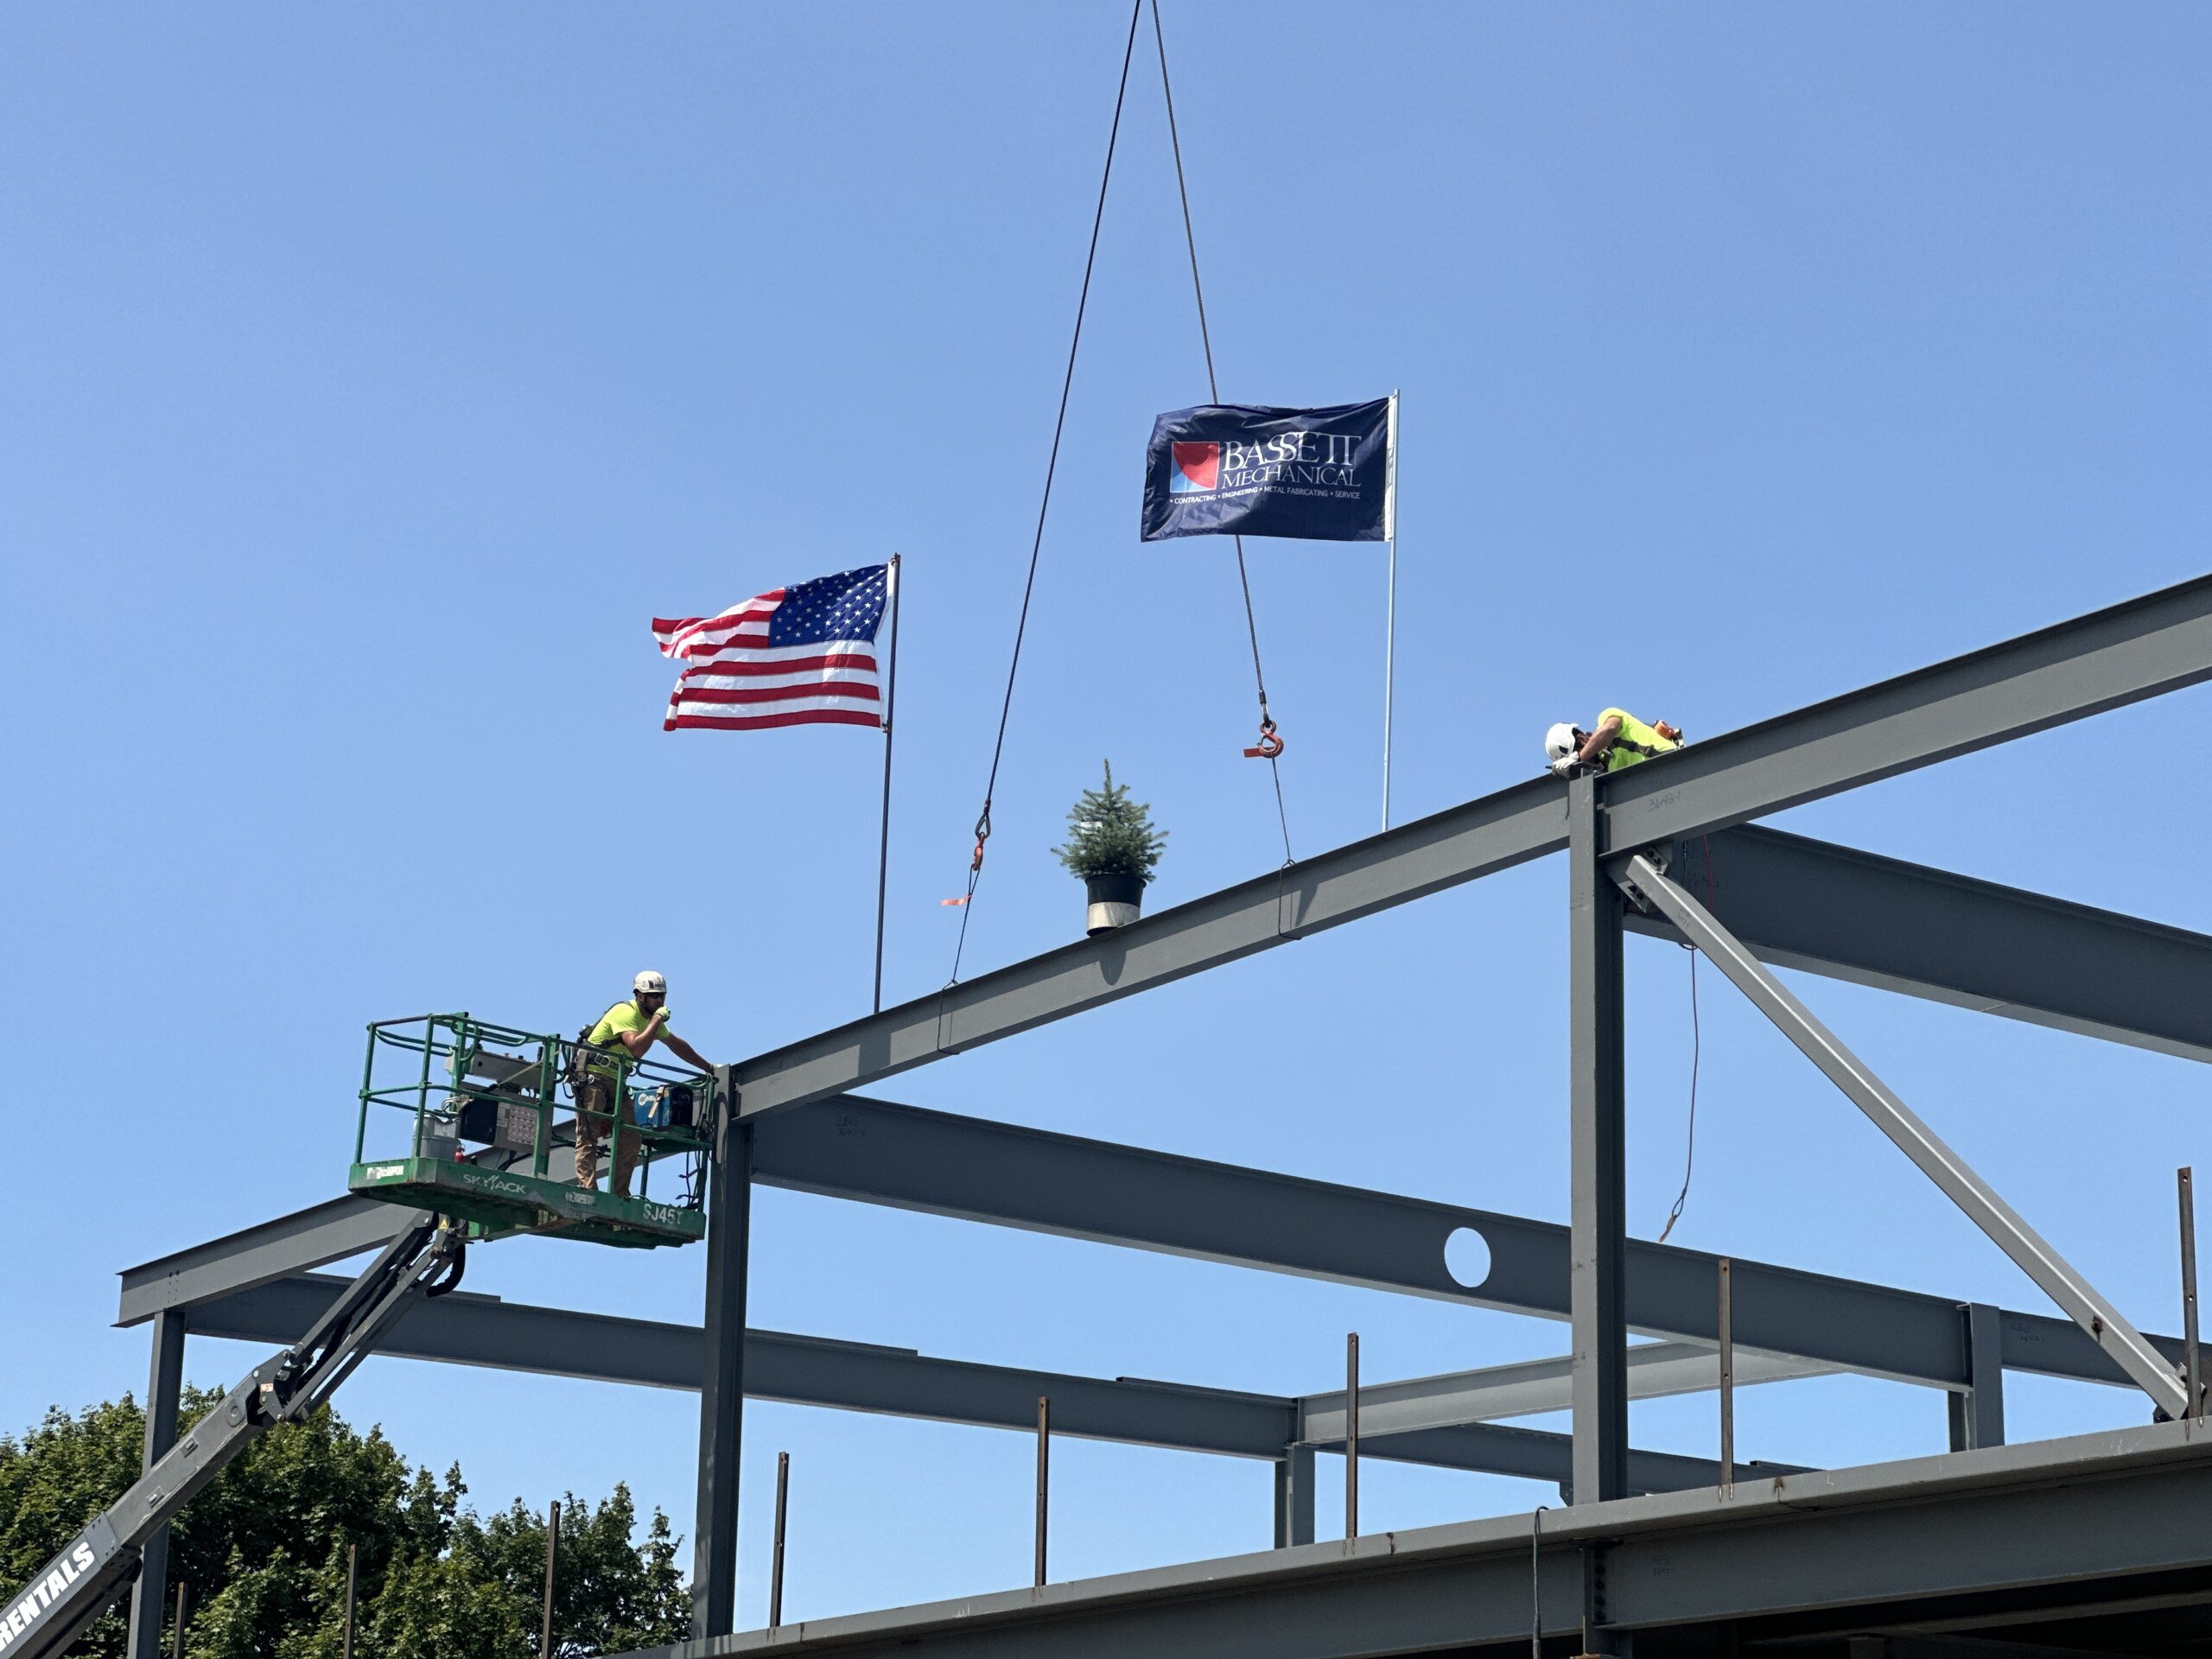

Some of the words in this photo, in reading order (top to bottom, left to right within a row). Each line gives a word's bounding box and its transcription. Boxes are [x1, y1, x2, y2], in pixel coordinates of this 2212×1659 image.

[1223, 431, 1362, 471] BASSETT
[1221, 465, 1362, 490] MECHANICAL
[1174, 493, 1216, 505] CONTRACTING
[1222, 486, 1258, 498] ENGINEERING
[1264, 486, 1286, 494] METAL
[1287, 487, 1328, 497] FABRICATING
[1335, 491, 1361, 499] SERVICE
[462, 1173, 526, 1194] SKYJACK
